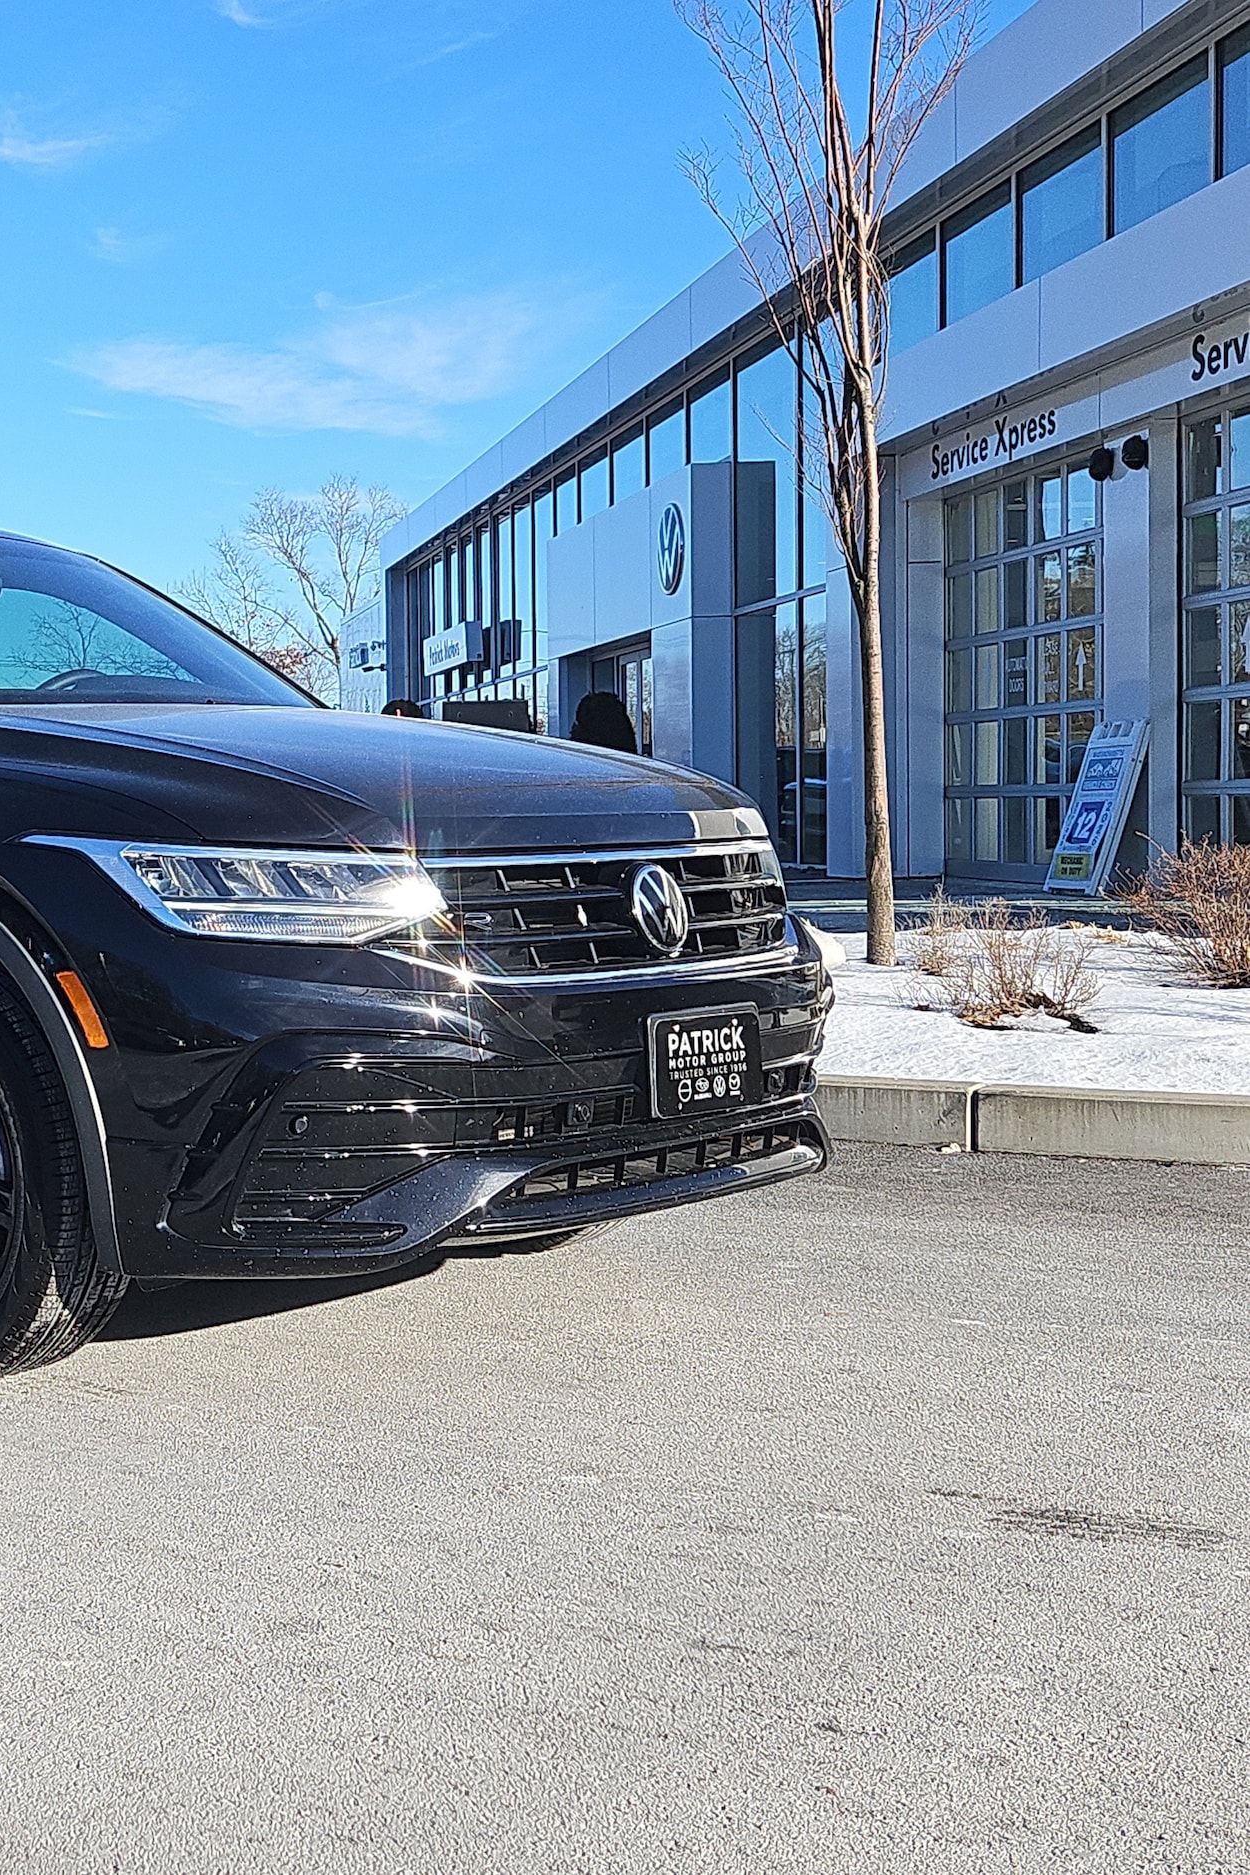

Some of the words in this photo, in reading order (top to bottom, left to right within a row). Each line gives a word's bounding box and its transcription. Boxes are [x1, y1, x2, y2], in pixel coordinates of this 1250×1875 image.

[931, 432, 989, 480] Service
[994, 409, 1056, 461] Xpress
[1073, 811, 1097, 838] 12
[667, 1026, 745, 1058] PATRICK
[668, 1054, 707, 1070] MOTOR
[710, 1050, 747, 1065] GROUP
[669, 1067, 704, 1081] TRUSTED
[706, 1063, 729, 1076] SINCE
